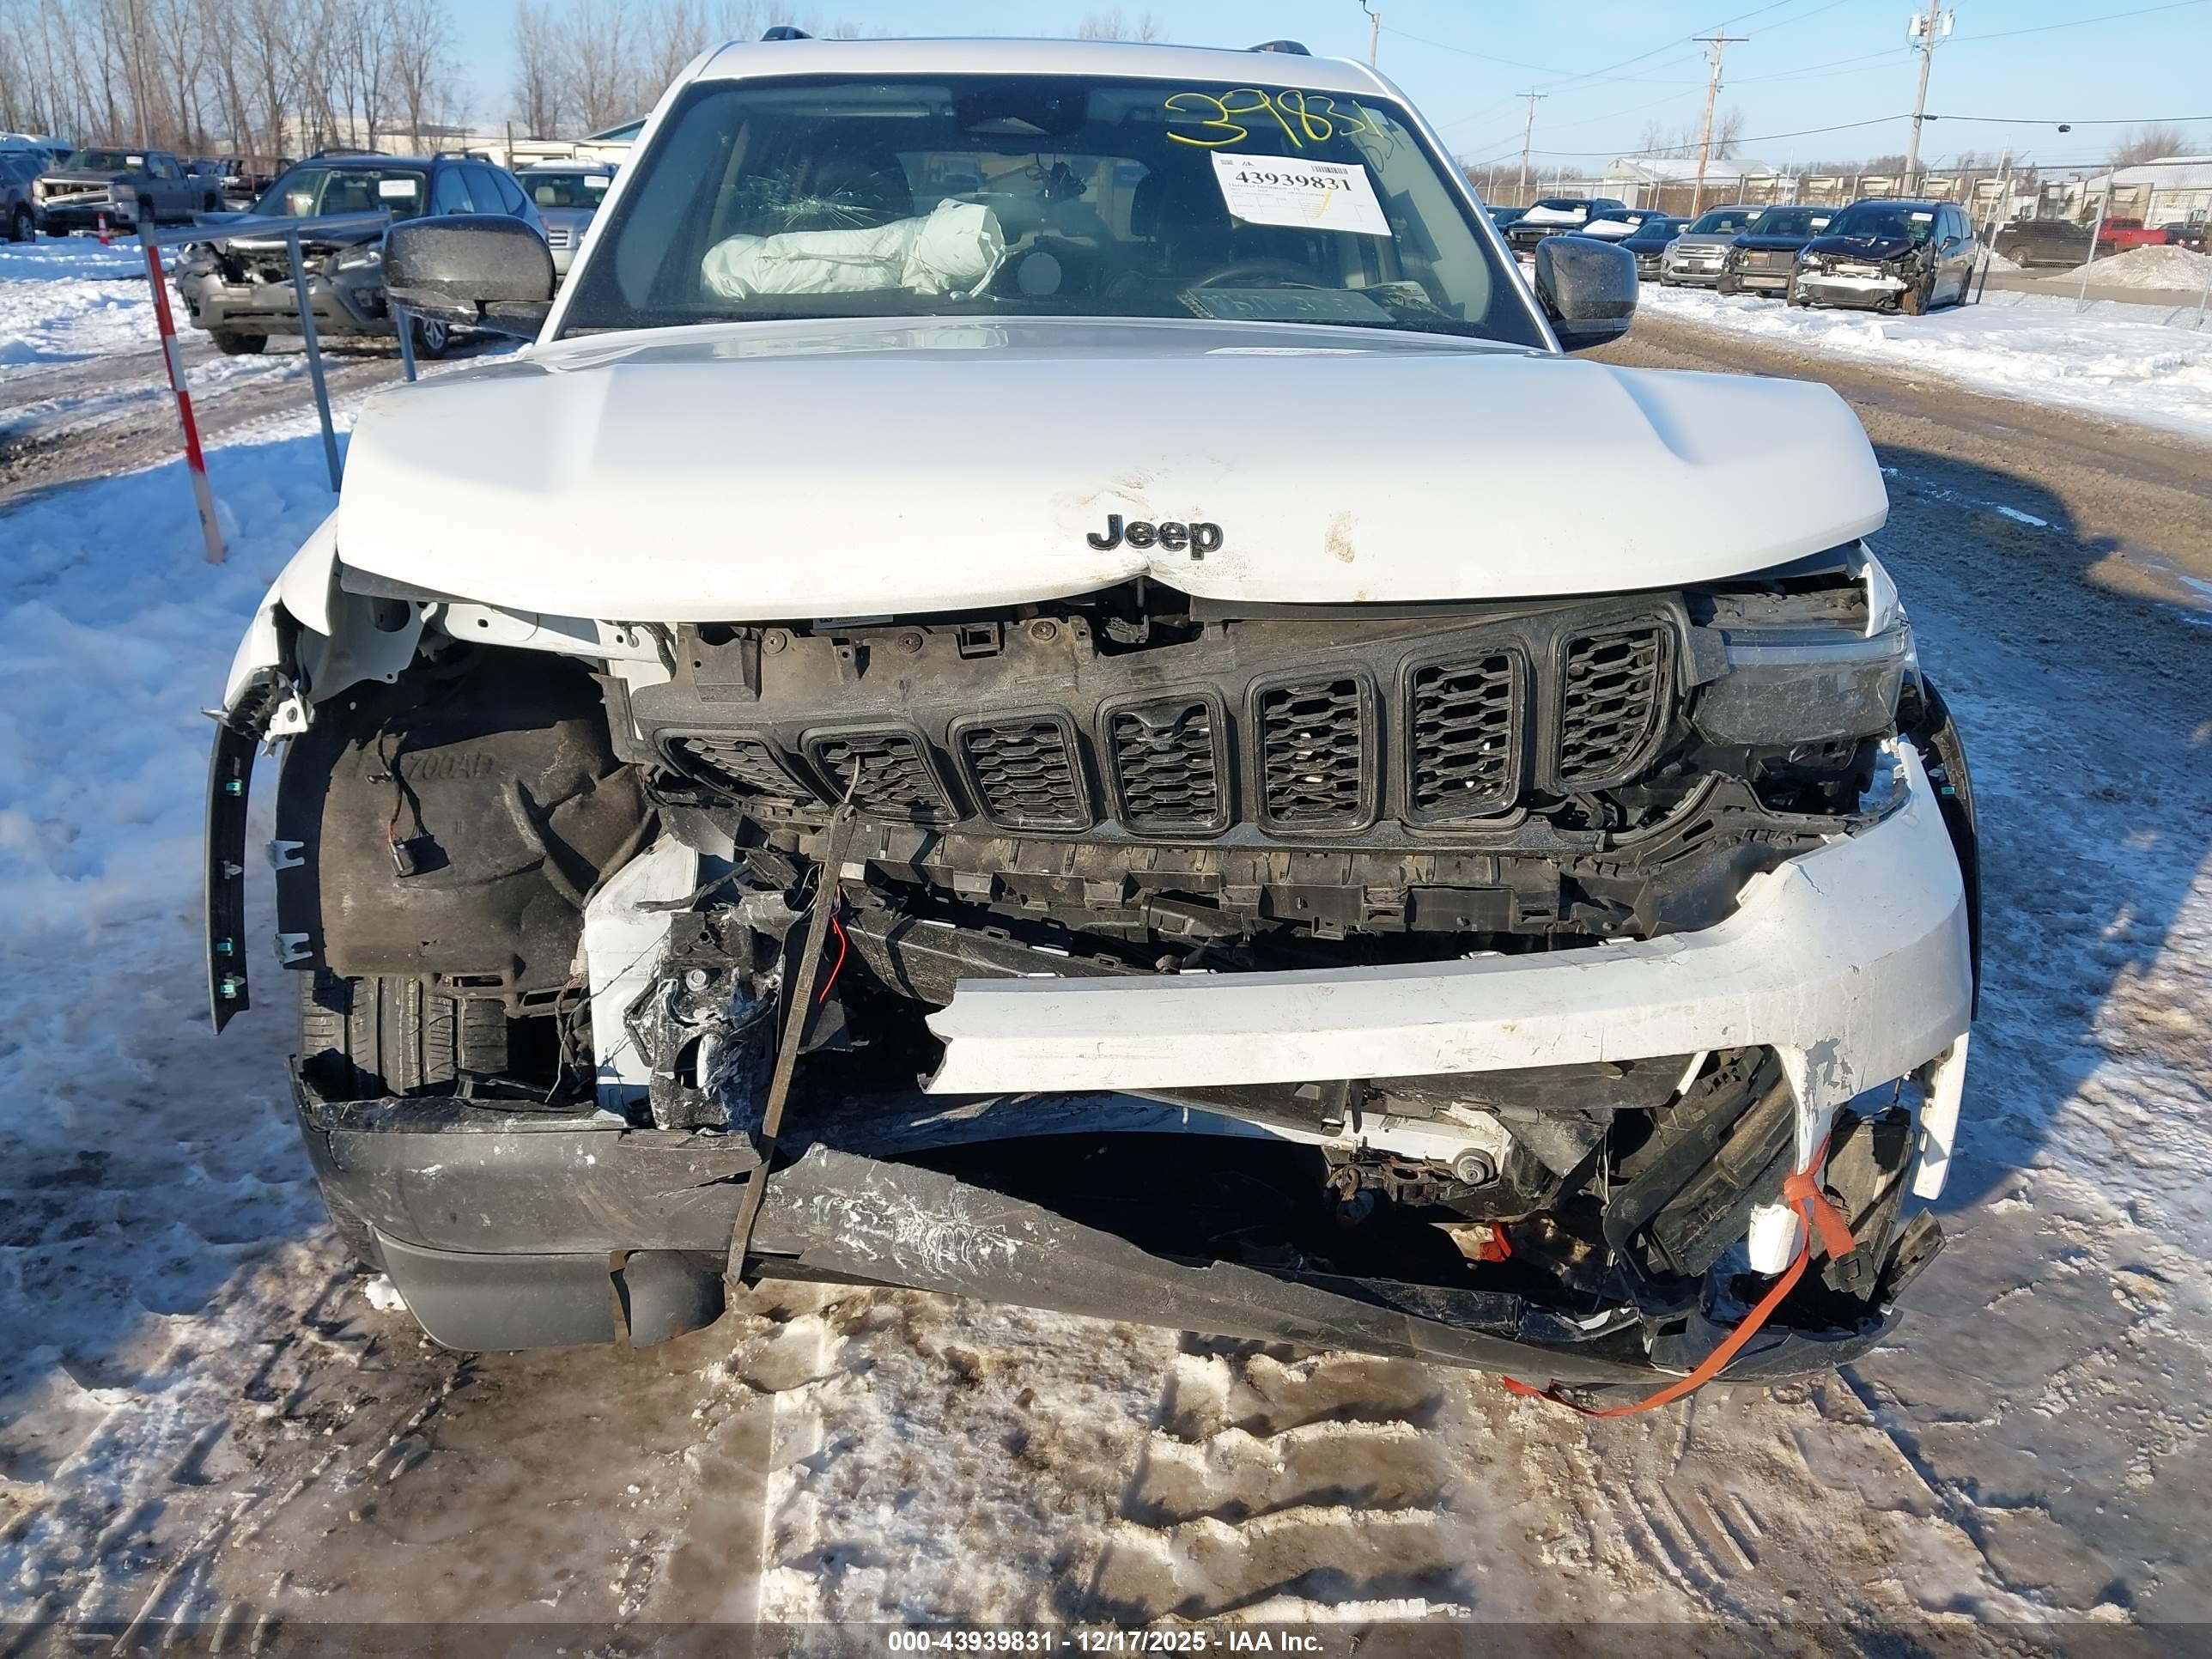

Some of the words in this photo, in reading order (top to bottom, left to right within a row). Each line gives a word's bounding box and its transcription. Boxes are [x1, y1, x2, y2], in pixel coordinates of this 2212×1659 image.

[1164, 88, 1384, 149] 39831
[1236, 170, 1354, 191] 43939831
[1086, 514, 1224, 561] Jeep
